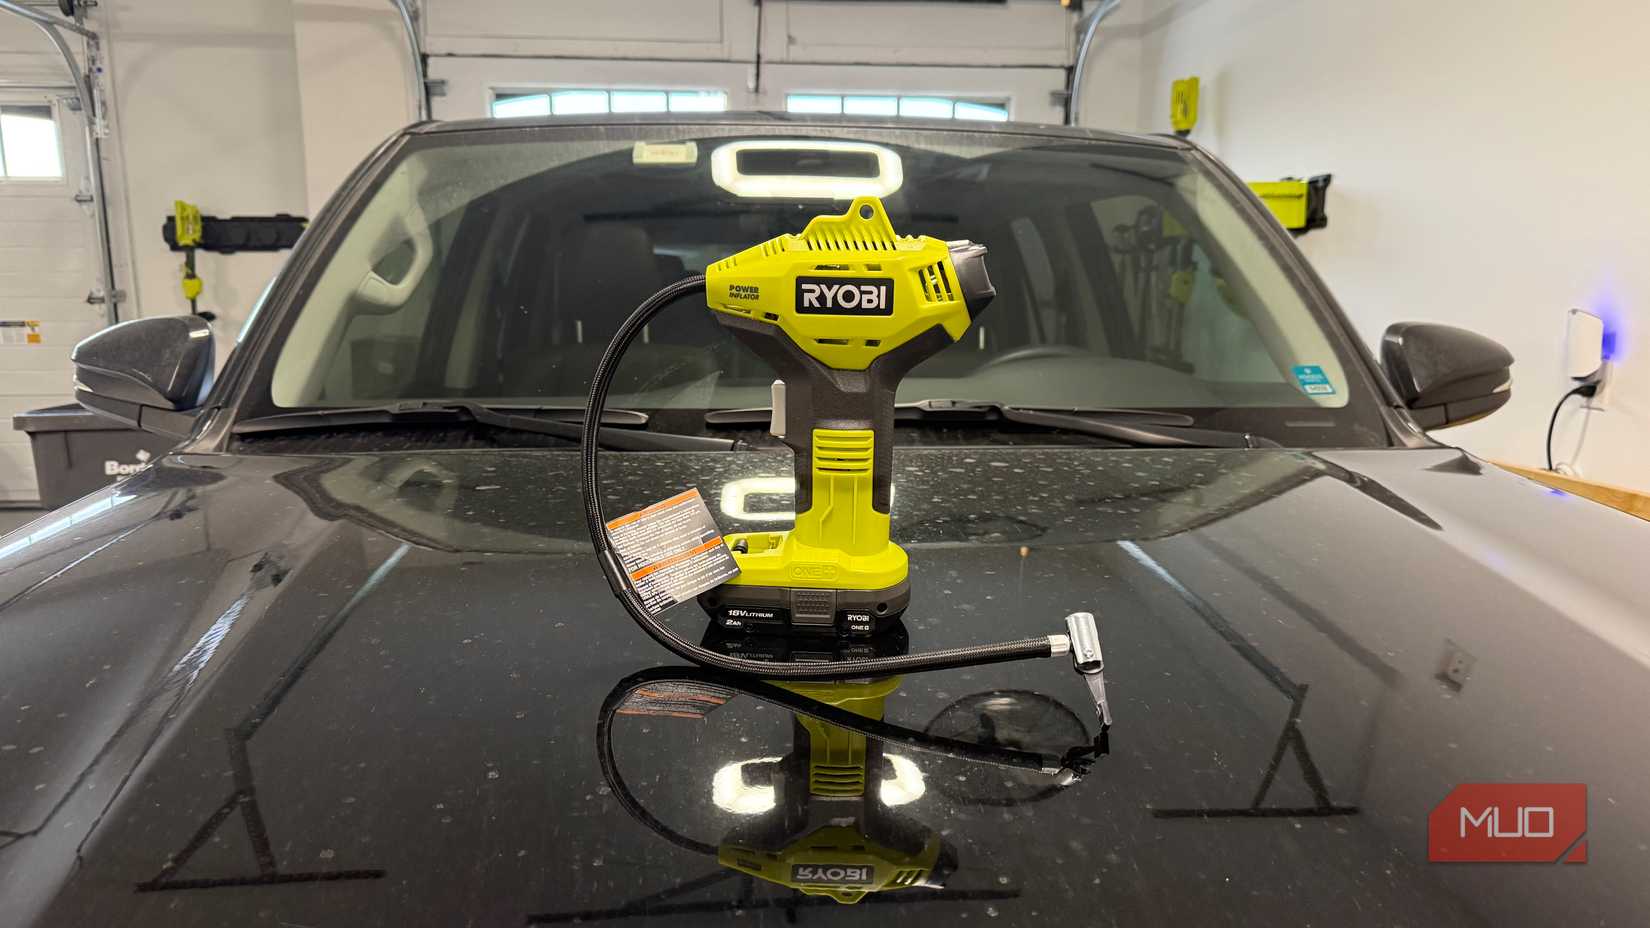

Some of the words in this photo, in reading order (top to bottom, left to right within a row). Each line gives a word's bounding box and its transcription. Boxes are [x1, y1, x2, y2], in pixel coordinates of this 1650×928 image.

[729, 284, 760, 294] POWER
[729, 292, 760, 301] INFLATOR
[801, 283, 887, 310] RYOBI
[847, 614, 870, 622] RYOBI
